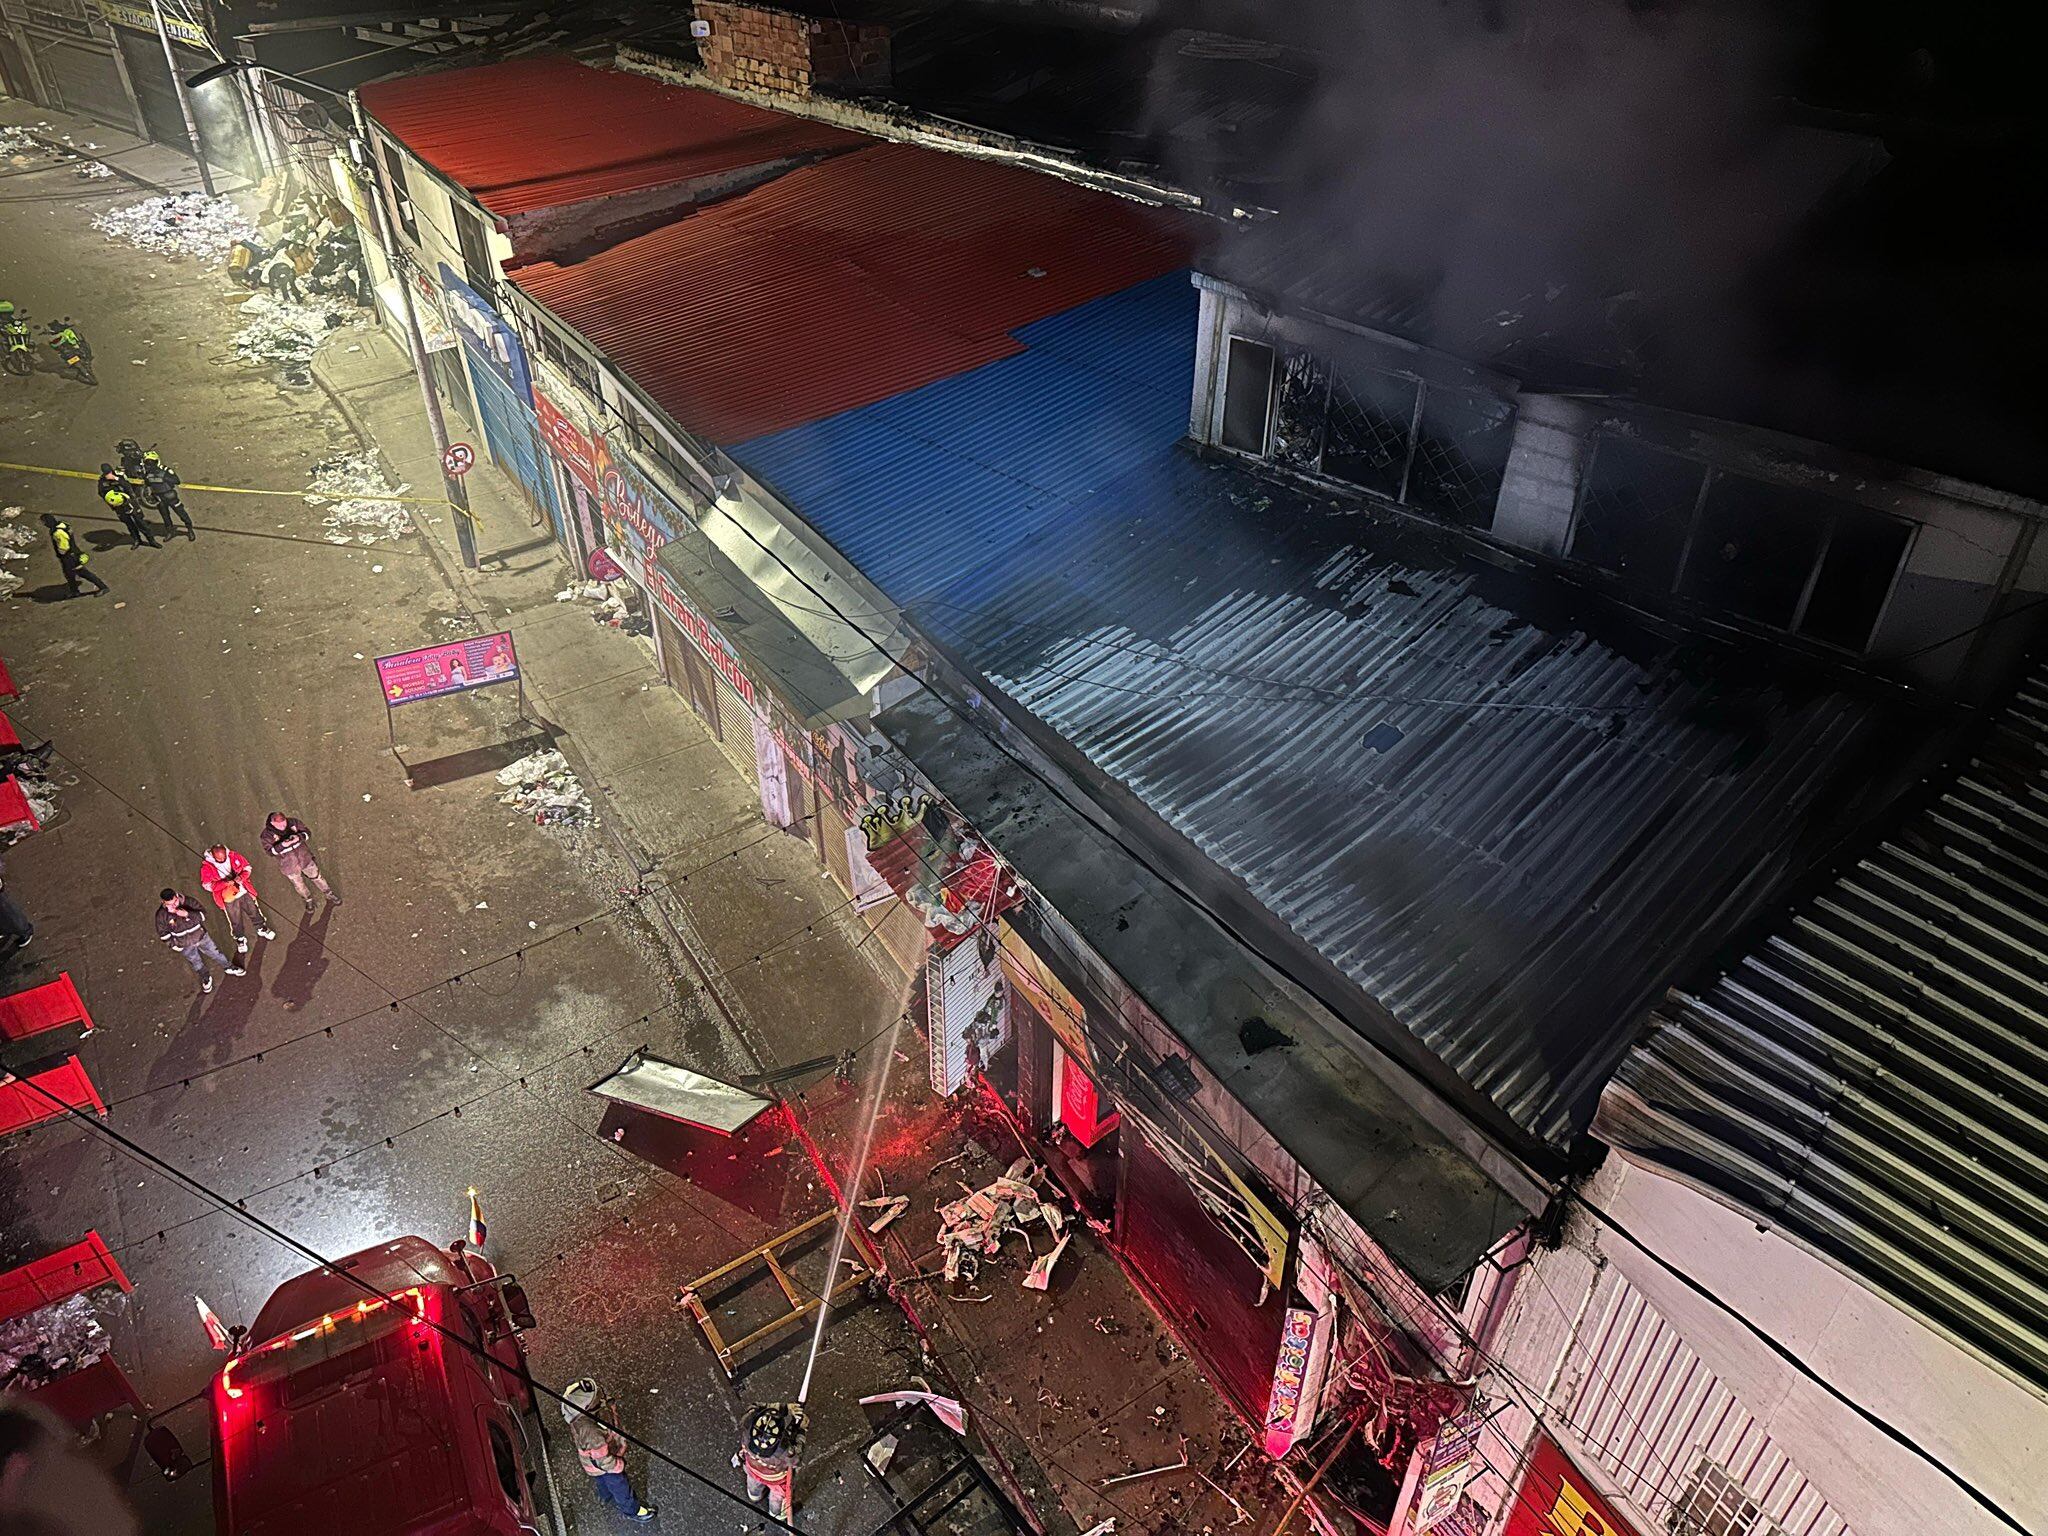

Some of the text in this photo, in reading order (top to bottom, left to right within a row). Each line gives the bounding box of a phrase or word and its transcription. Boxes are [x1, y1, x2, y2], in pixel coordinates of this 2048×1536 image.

[165, 22, 205, 43] ENTRA
[657, 570, 698, 641] Gran
[697, 615, 756, 707] Balcón
